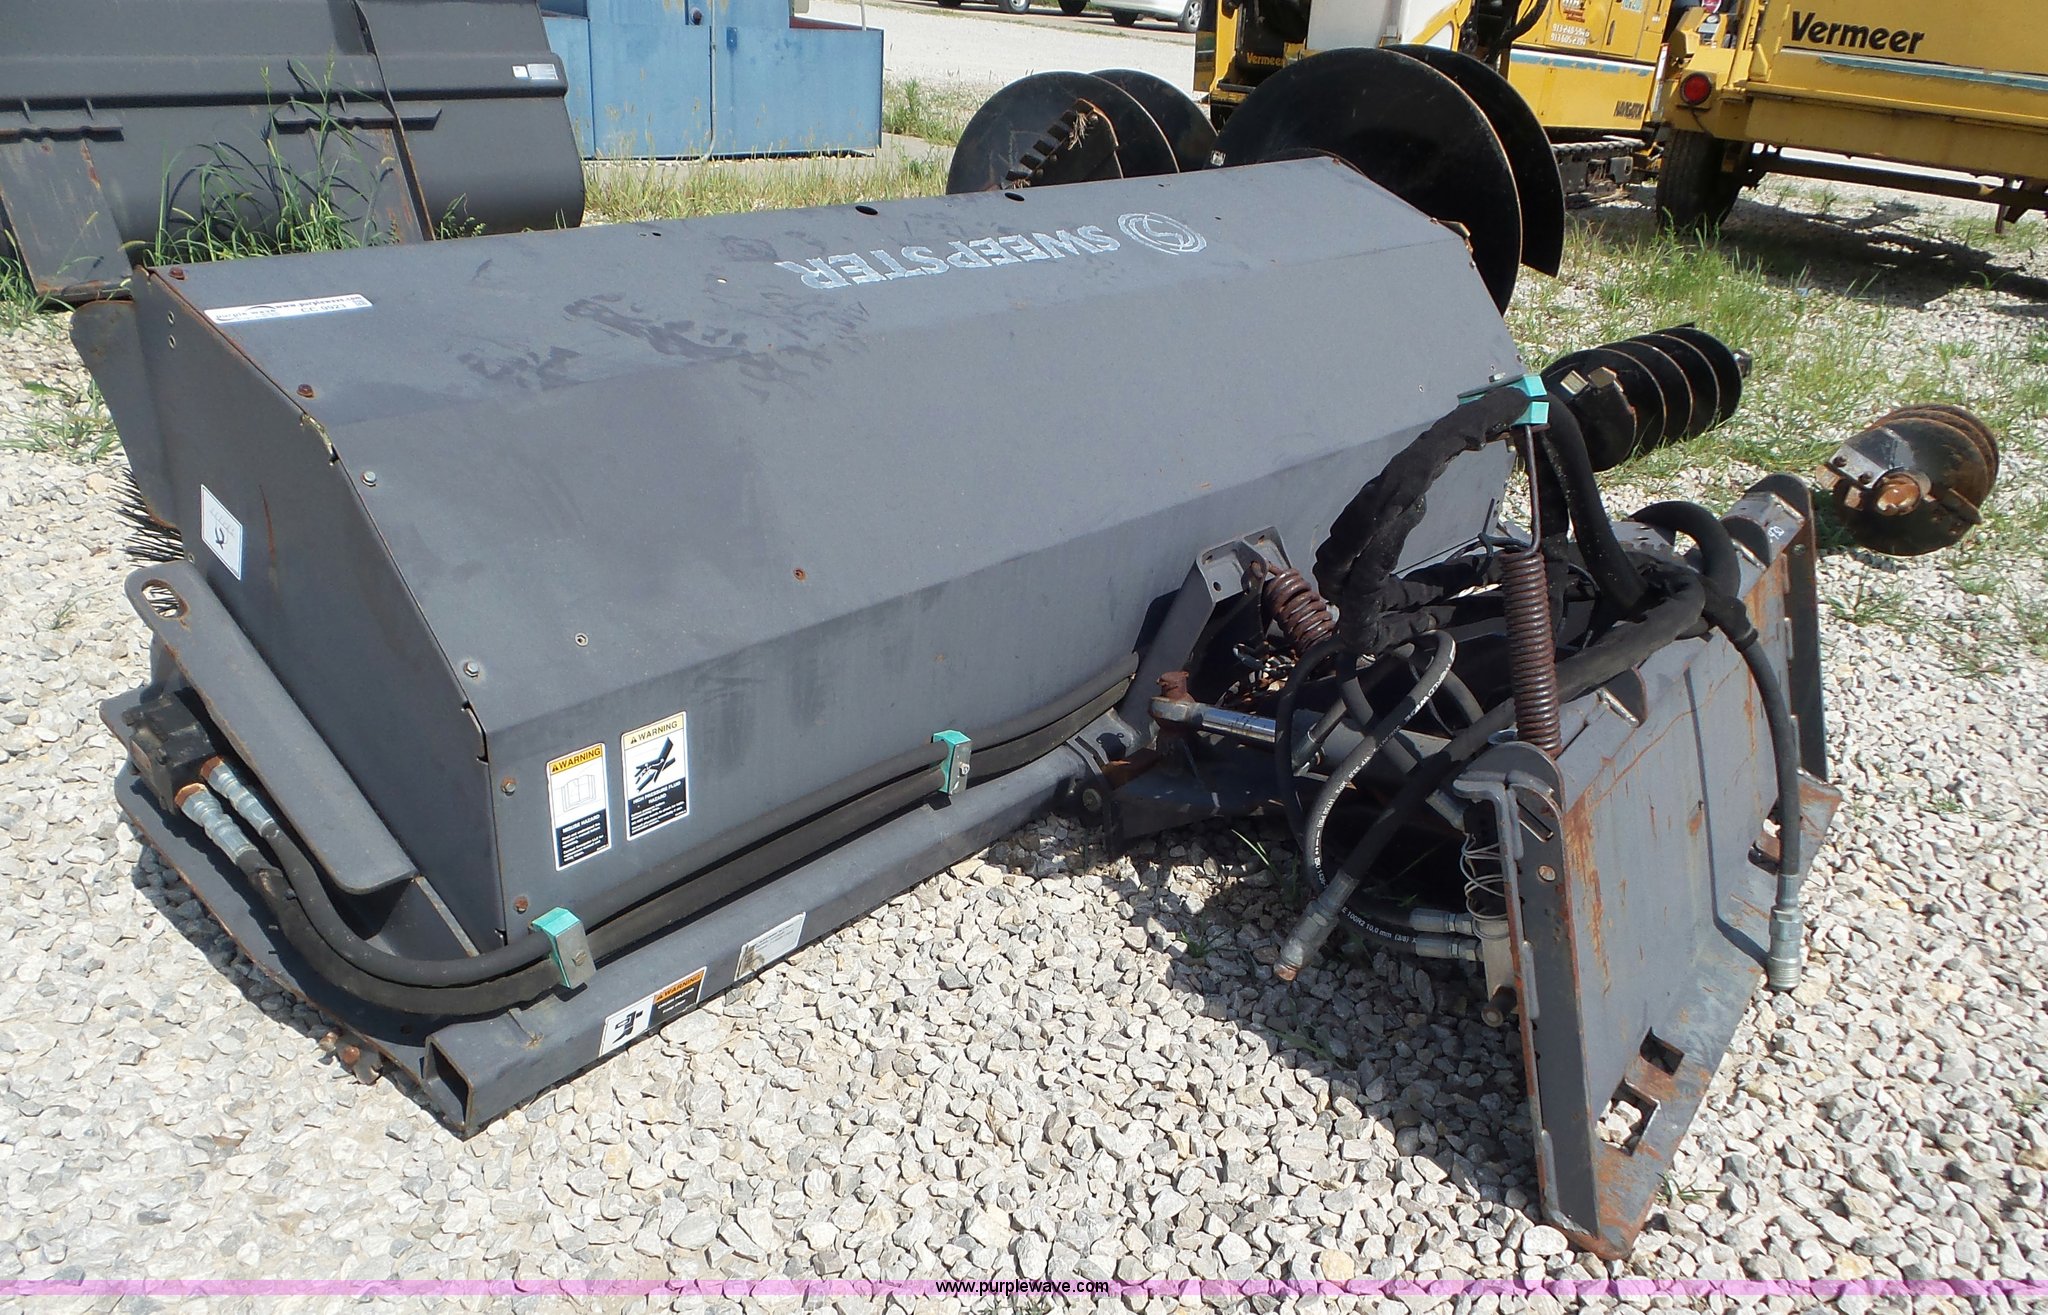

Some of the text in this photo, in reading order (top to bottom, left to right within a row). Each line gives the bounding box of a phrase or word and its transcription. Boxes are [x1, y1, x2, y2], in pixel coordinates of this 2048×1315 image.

[1791, 11, 1925, 54] Vermeer
[774, 225, 1121, 289] SWEEPSTER
[638, 720, 678, 741] WARNING
[558, 747, 601, 769] WARNING
[1379, 930, 1392, 938] mm
[664, 973, 702, 997] WARNING
